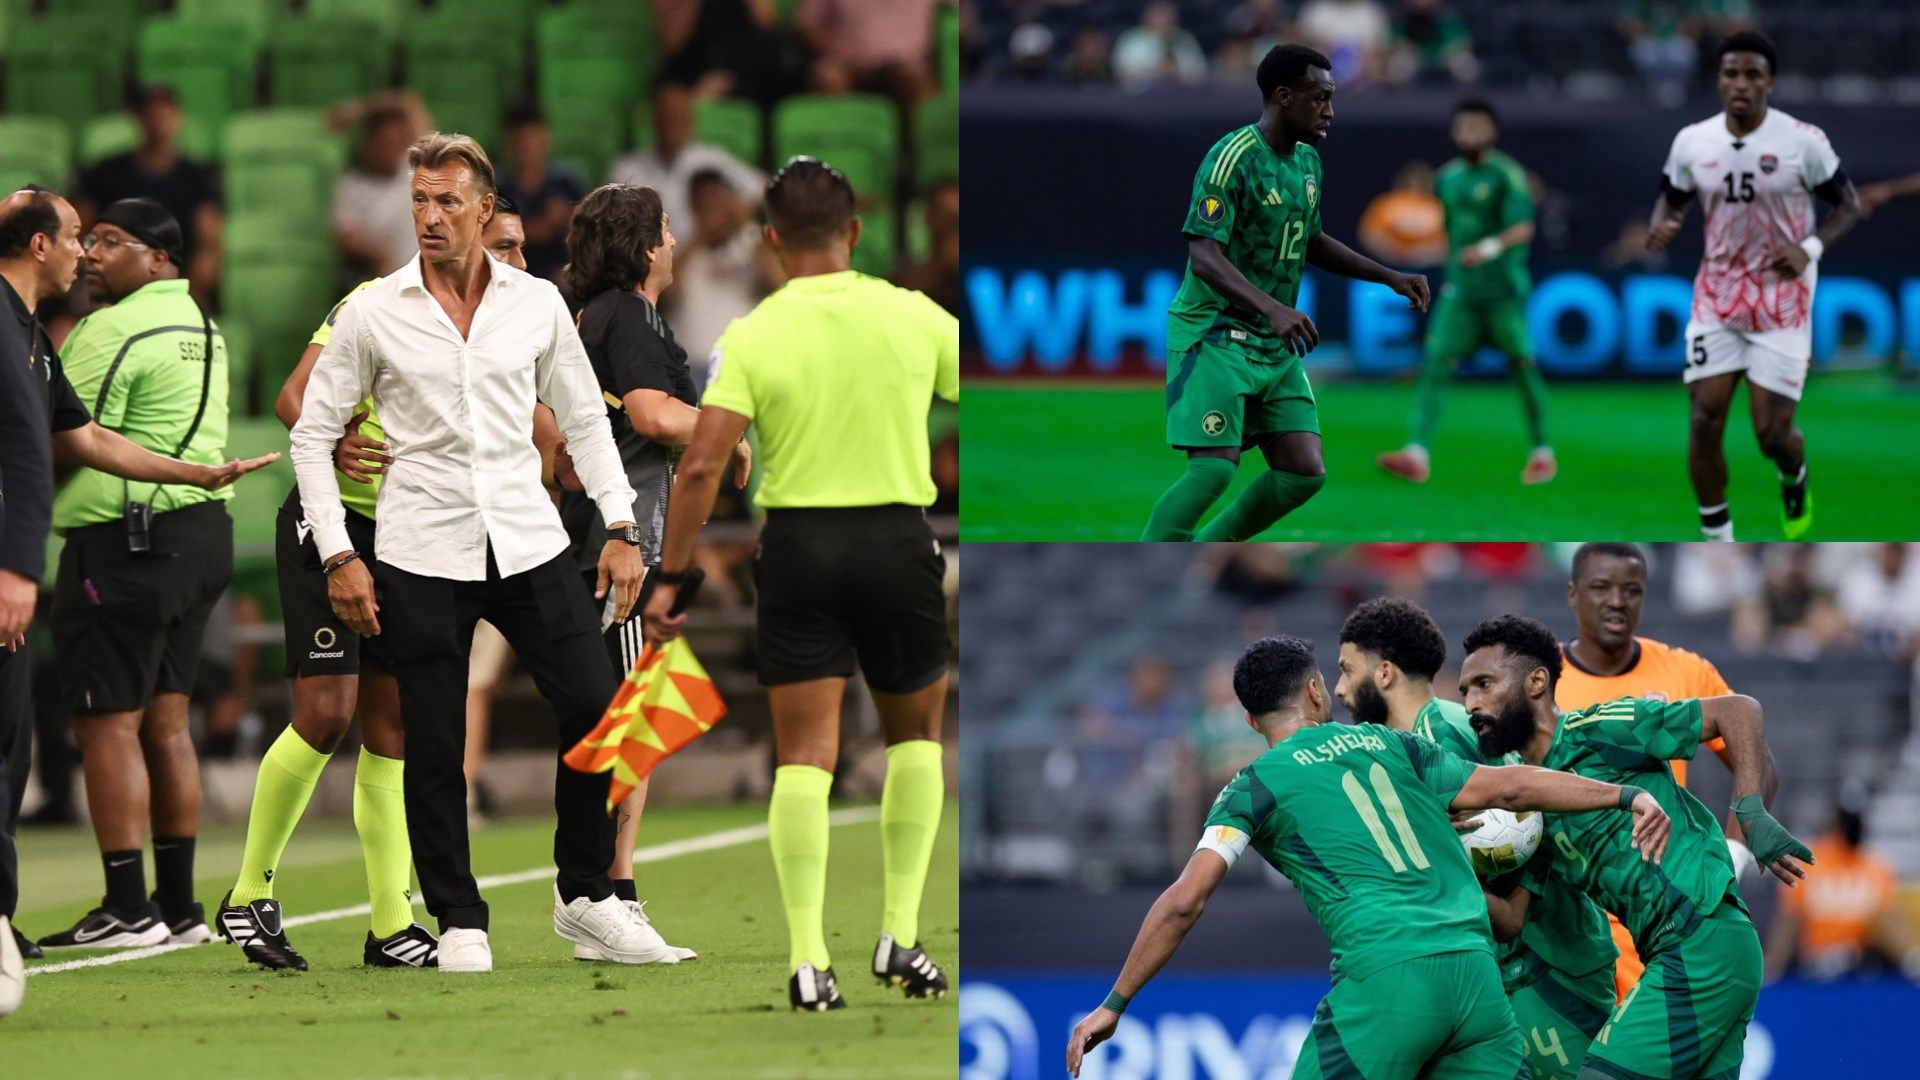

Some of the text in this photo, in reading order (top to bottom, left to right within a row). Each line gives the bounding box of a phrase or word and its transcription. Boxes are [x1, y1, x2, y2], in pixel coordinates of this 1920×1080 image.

[1724, 171, 1755, 203] 15
[1279, 220, 1304, 260] 12
[966, 267, 1421, 371] WHLE
[309, 650, 344, 659] Concacaf
[1292, 733, 1387, 766] ALSHEHRI
[1341, 761, 1431, 873] 11
[1554, 831, 1587, 873] 9
